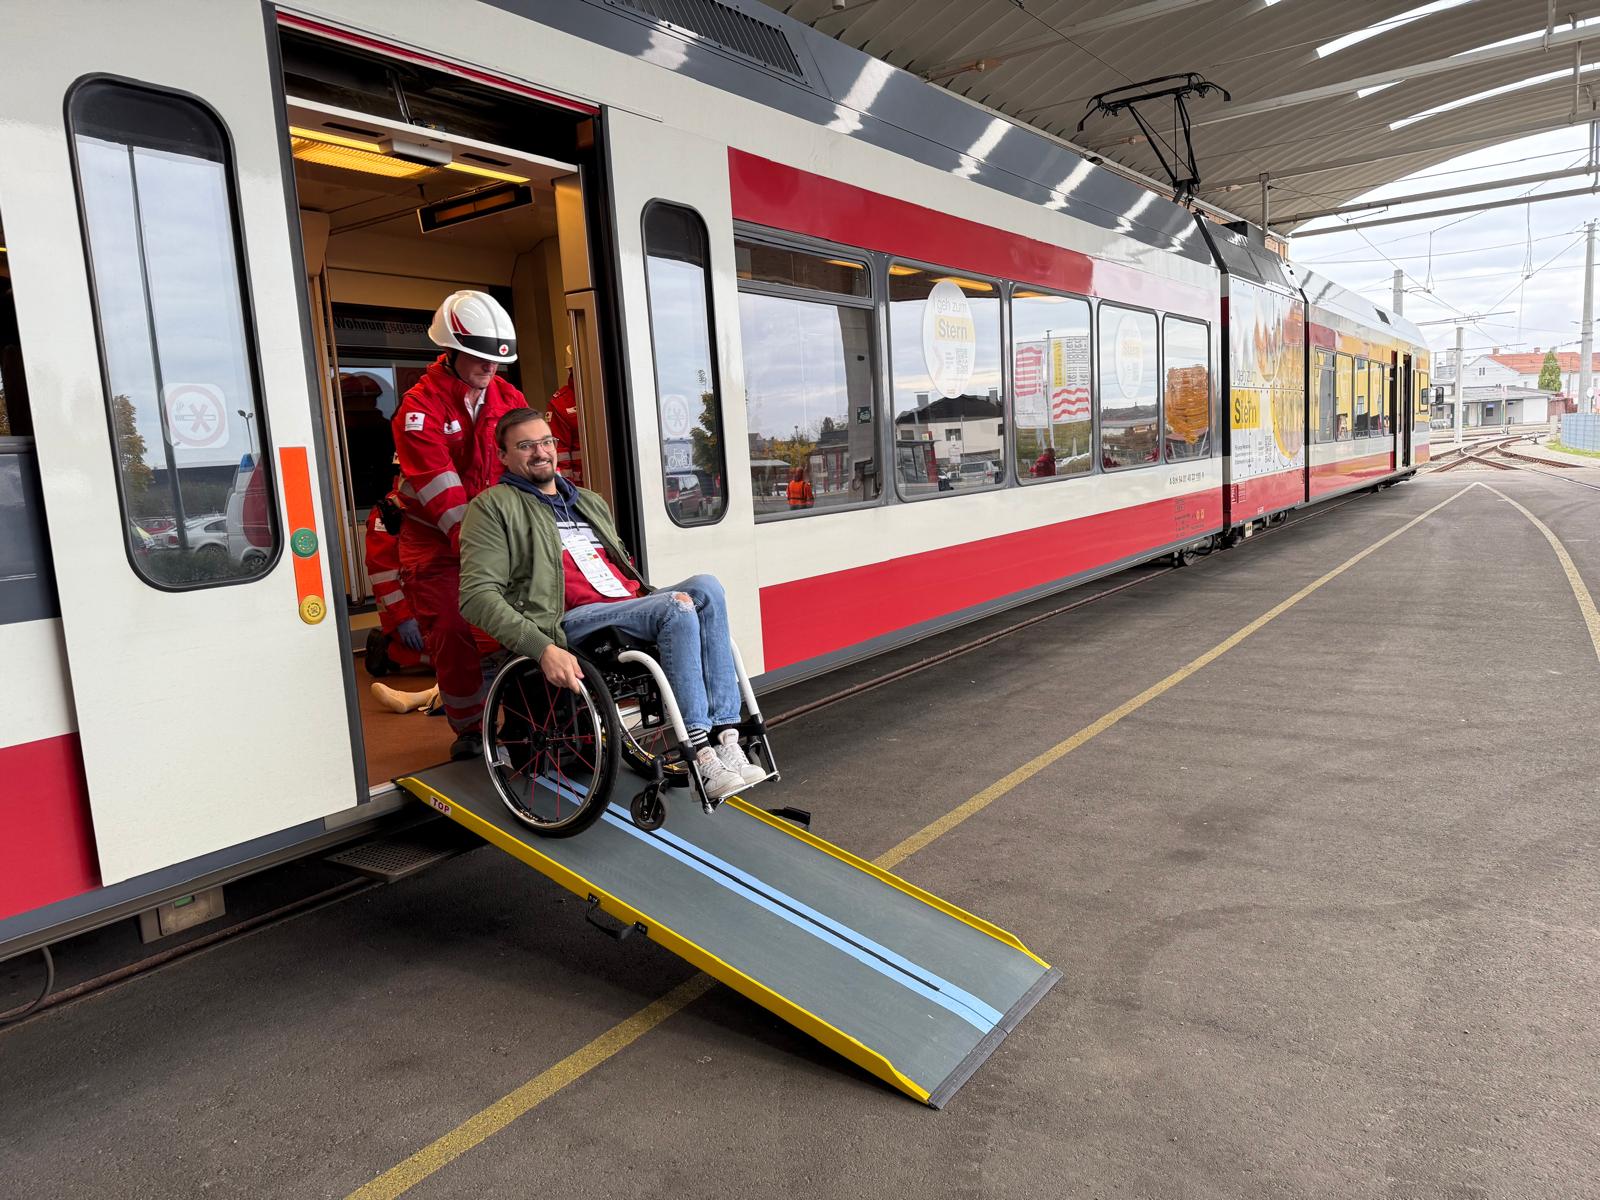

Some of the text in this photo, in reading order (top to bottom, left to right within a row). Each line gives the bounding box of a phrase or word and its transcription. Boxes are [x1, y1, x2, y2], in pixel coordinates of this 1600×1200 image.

[938, 318, 968, 340] Stern
[1234, 397, 1257, 424] Stern
[432, 797, 450, 813] TOP
